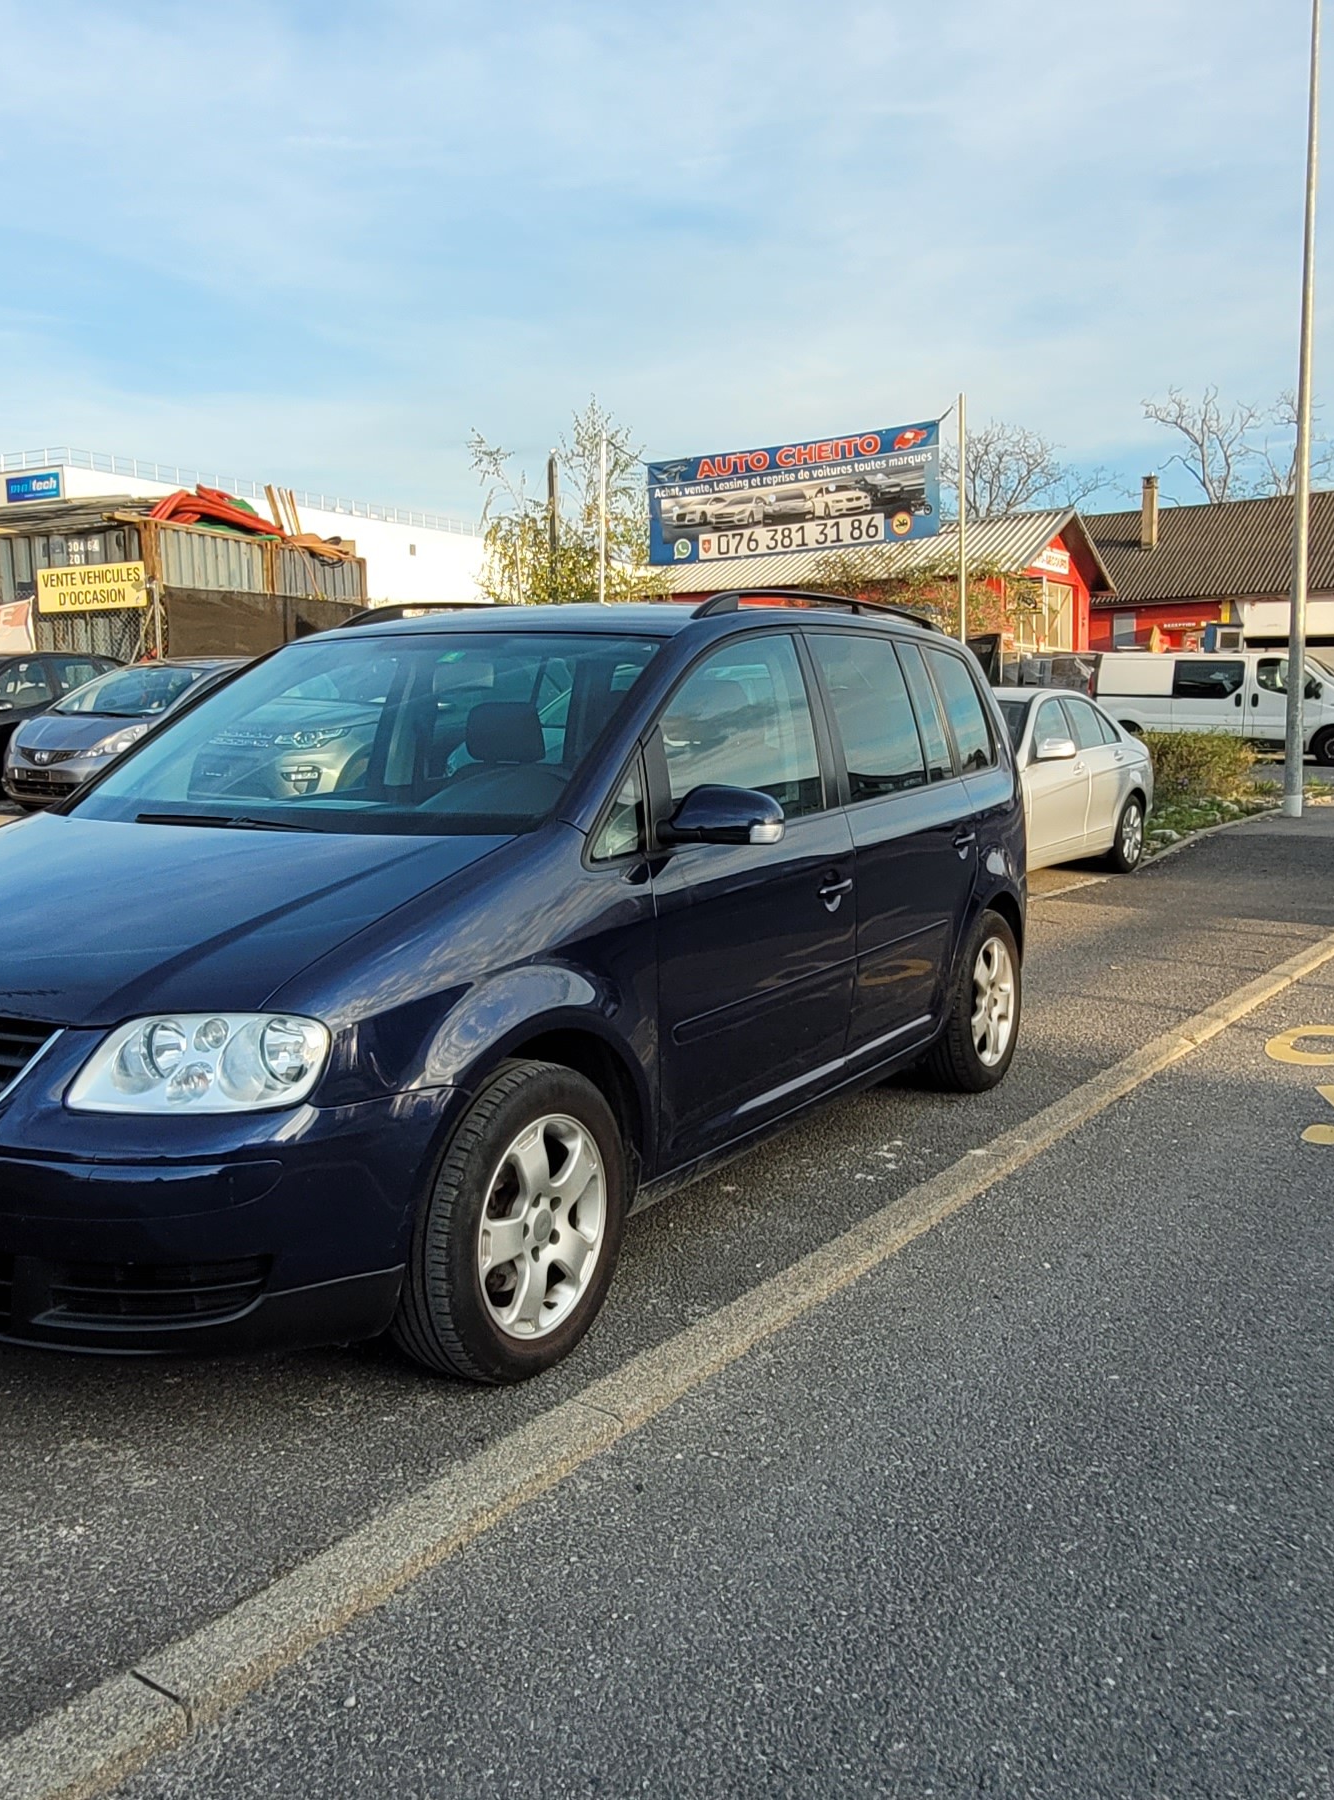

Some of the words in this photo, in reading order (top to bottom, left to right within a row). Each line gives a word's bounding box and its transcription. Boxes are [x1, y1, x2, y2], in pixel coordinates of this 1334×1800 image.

[697, 451, 769, 479] AUTO
[776, 434, 881, 467] CHEITO
[714, 478, 749, 491] Leasing
[751, 476, 761, 487] et
[763, 471, 795, 488] reprise
[798, 468, 810, 480] de
[811, 464, 852, 478] voitures
[854, 459, 887, 472] toutes
[888, 452, 933, 467] marques
[717, 531, 760, 556] 076
[766, 525, 809, 550] 381
[815, 521, 844, 545] 31
[849, 516, 879, 541] 86
[42, 571, 77, 588] VENTE
[79, 566, 141, 586] VEHICULES
[58, 588, 126, 606] D'OCCASION
